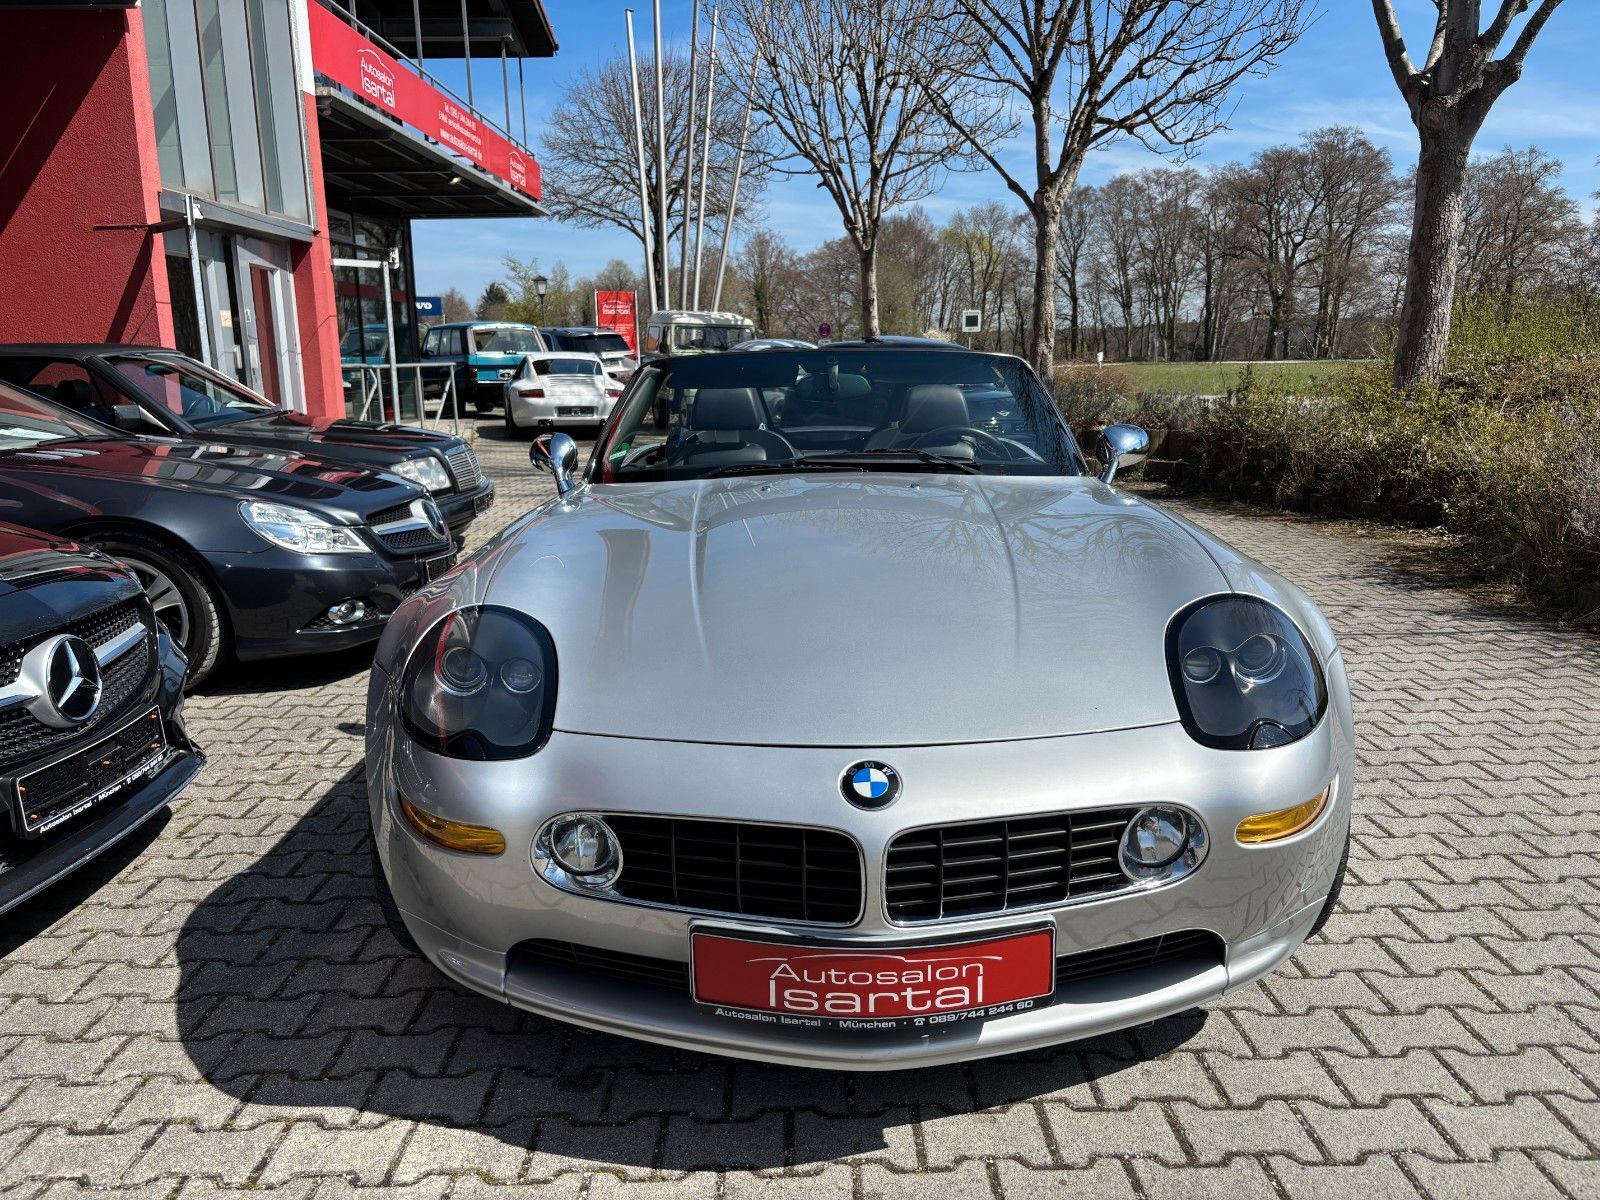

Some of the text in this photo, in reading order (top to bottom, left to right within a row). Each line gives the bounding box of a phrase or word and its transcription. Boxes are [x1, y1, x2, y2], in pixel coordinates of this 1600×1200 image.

[361, 57, 394, 88] Autosalon
[361, 70, 395, 109] Isartal
[416, 302, 432, 310] VO
[40, 812, 72, 833] Autosalon
[98, 784, 122, 801] München
[770, 963, 984, 985] Autosalon
[769, 976, 983, 1013] Isartal
[715, 1000, 1034, 1029] Autosalon Isartal München 089/744 244 60
